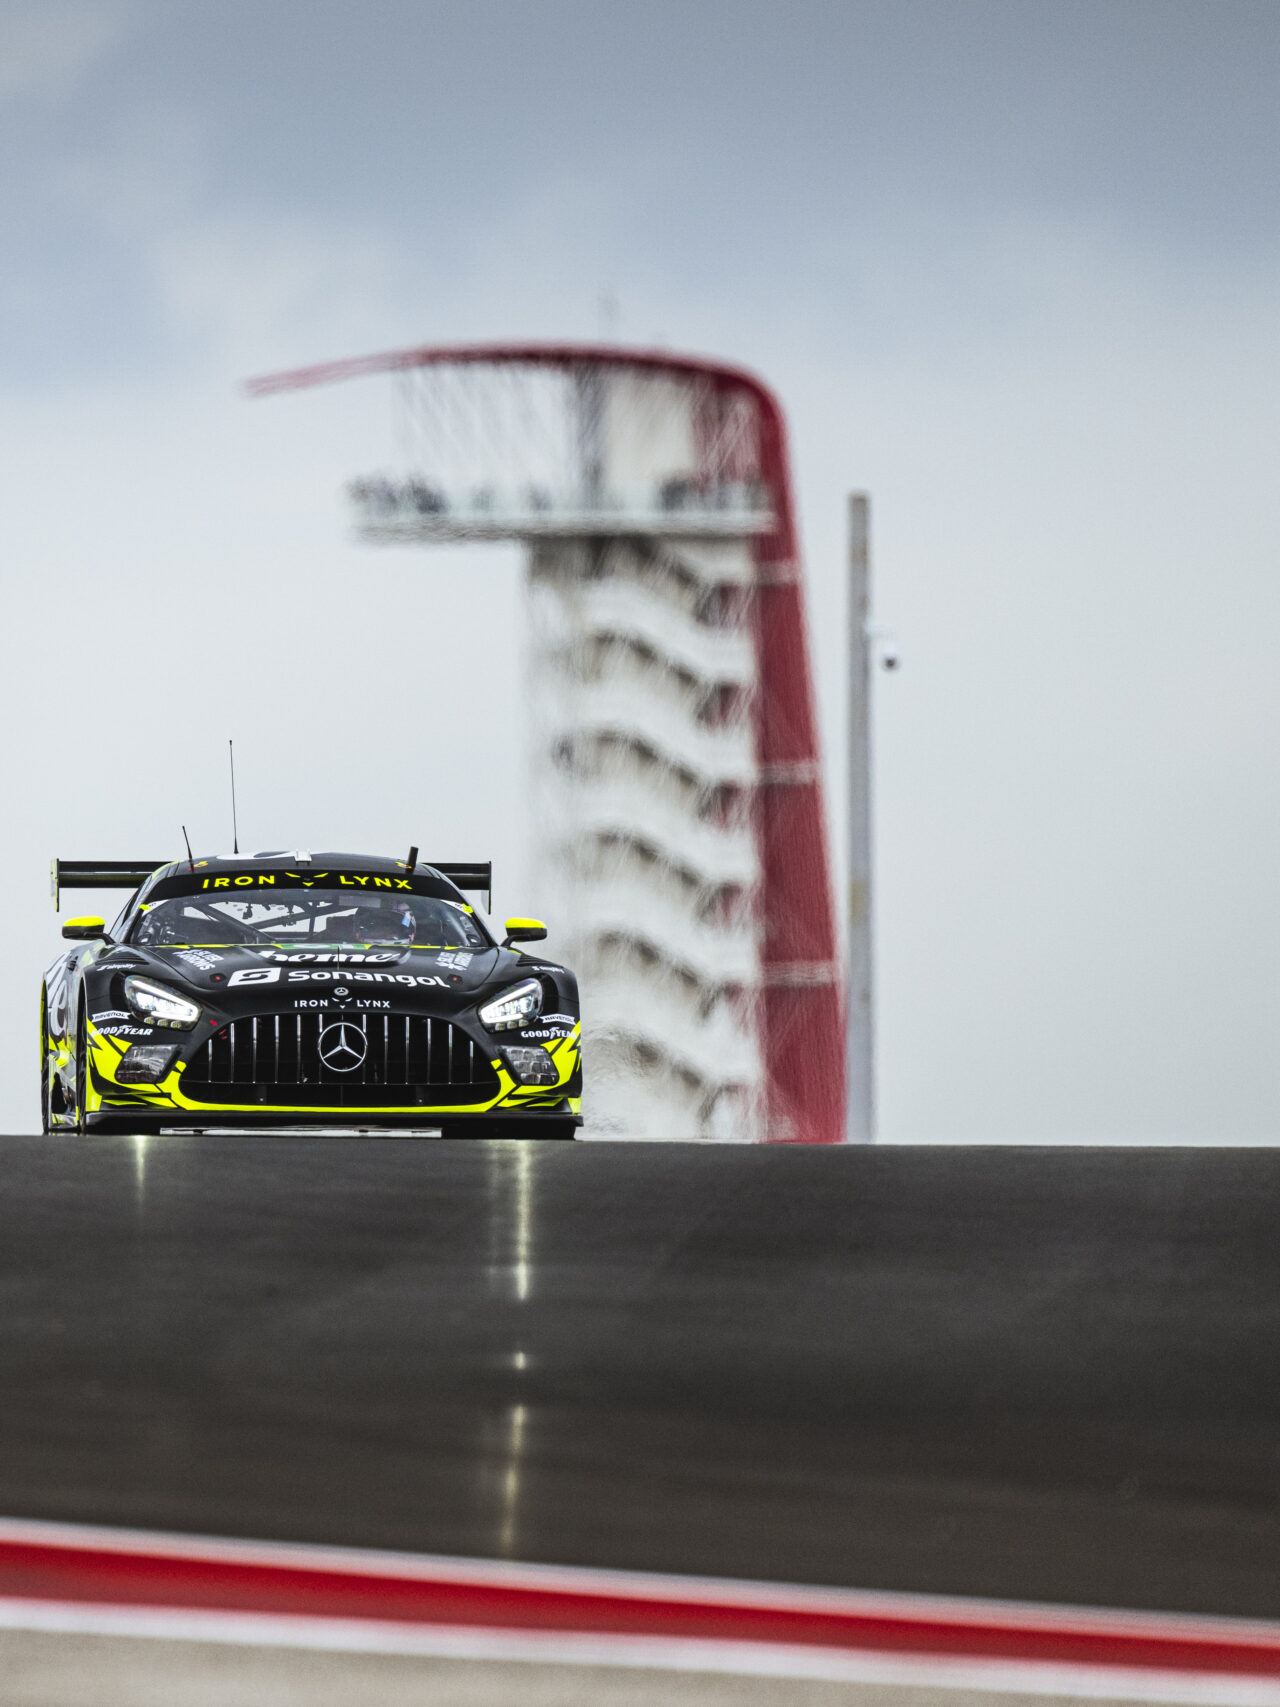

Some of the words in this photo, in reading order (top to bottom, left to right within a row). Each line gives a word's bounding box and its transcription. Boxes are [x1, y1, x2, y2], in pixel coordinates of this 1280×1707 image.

[203, 875, 275, 889] IRON
[340, 875, 413, 890] LYNX
[288, 970, 450, 988] Sonangol
[294, 999, 329, 1008] IRON
[357, 1000, 391, 1008] LYNX
[91, 1025, 154, 1037] GOODYEAR
[520, 1027, 577, 1039] GOODYEAR
